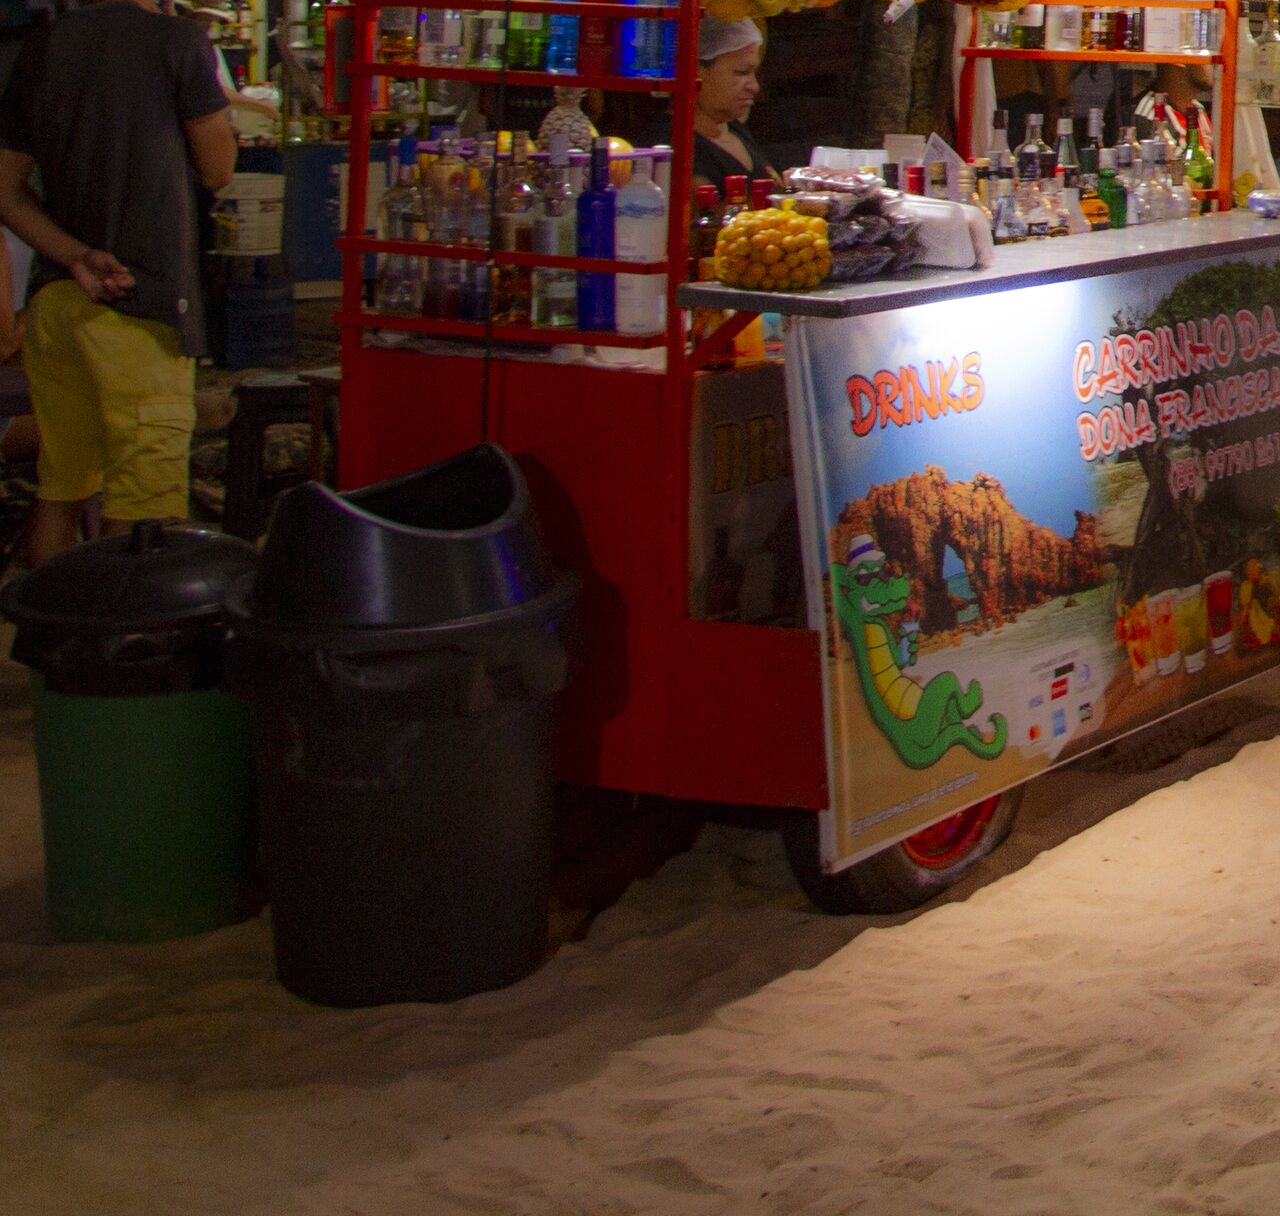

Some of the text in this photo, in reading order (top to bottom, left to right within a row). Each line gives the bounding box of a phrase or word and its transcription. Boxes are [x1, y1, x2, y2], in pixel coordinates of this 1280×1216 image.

[846, 350, 984, 437] DRINKS
[1072, 312, 1235, 404] CARRINHO
[1076, 398, 1157, 462] DONA
